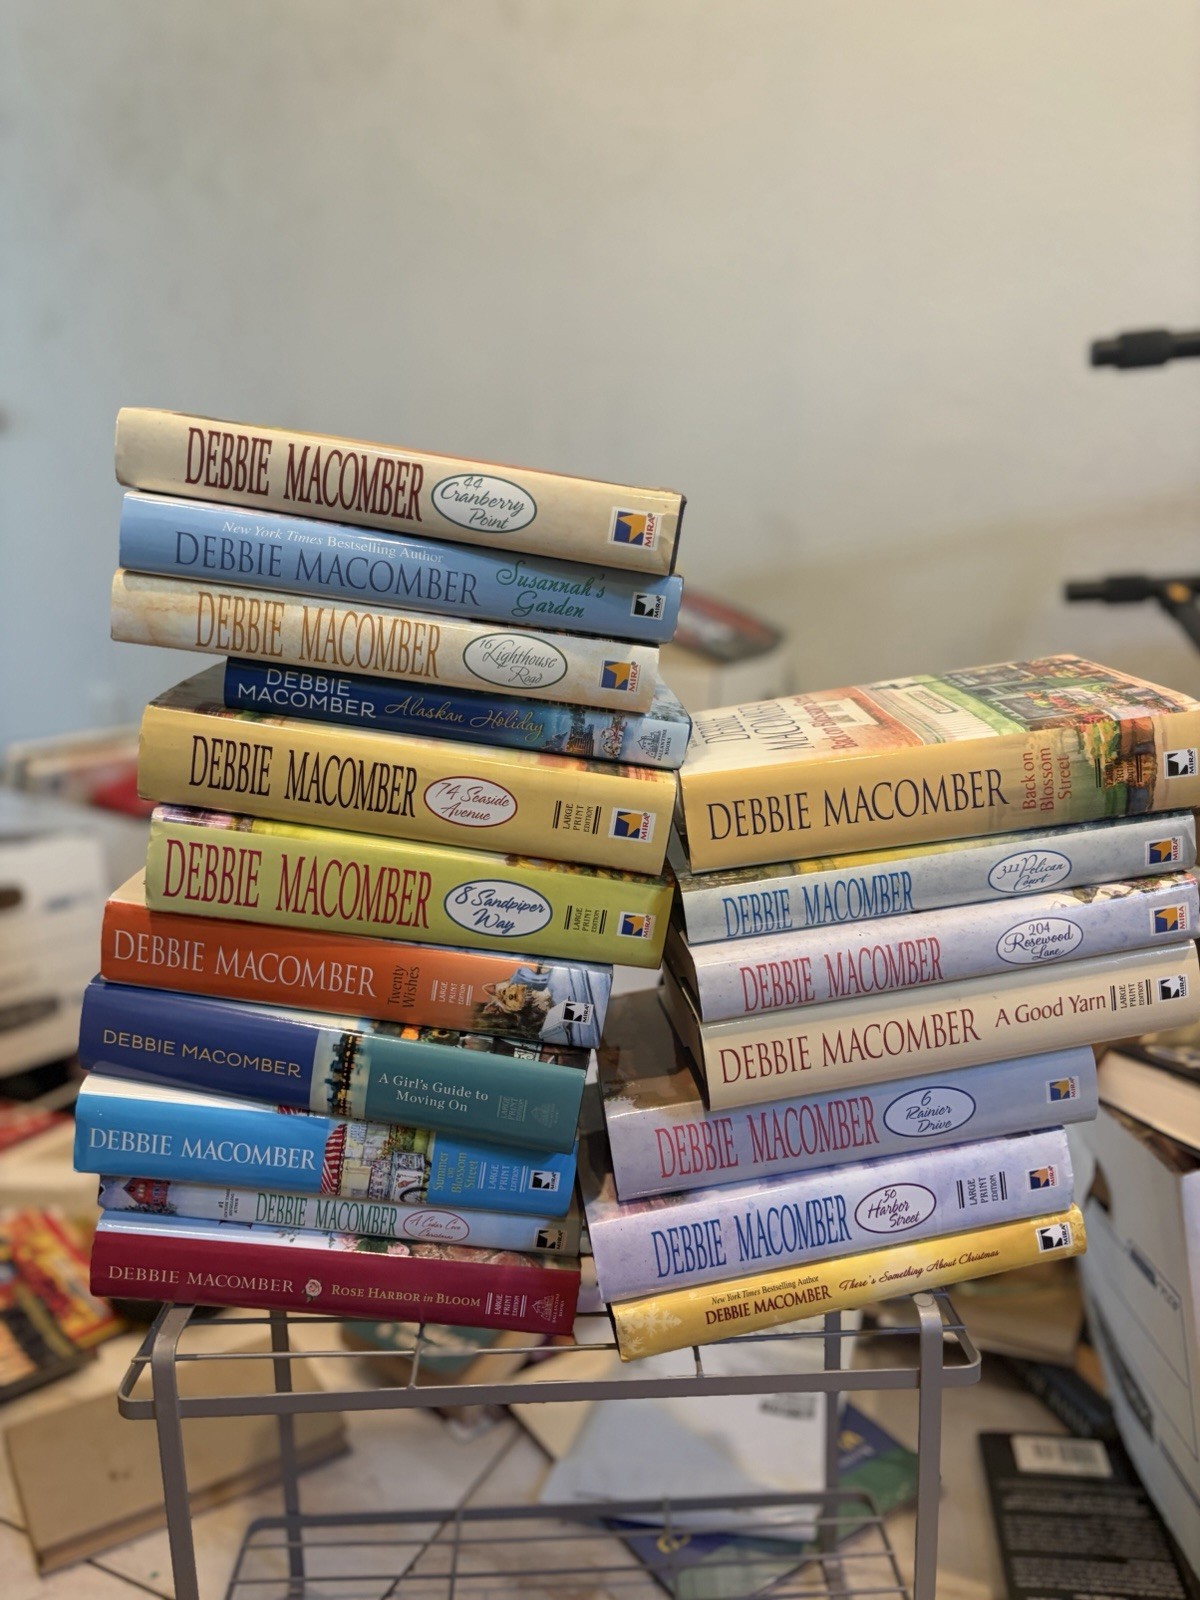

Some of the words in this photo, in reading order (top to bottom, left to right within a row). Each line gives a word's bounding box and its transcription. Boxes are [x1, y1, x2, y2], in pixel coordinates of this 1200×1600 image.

[185, 427, 272, 496] DEBBIE
[284, 443, 424, 522] MACOMBER
[463, 476, 483, 490] 44
[440, 482, 525, 516] Cranberry
[470, 508, 508, 530] Point
[222, 521, 251, 537] New
[253, 525, 282, 540] York
[286, 530, 323, 546] Times
[328, 536, 396, 558] Bestselling
[400, 548, 443, 563] Author
[174, 531, 282, 578] DEBBIE
[295, 550, 480, 606] MACOMBER
[496, 560, 605, 598] Susannah's
[511, 590, 584, 618] Garden
[196, 591, 285, 657] DEBBIE
[299, 605, 440, 678] MACOMBER
[480, 639, 492, 649] 16
[482, 640, 557, 670] Lighthouse
[267, 669, 351, 696] DEBBIE
[510, 666, 542, 685] Road
[238, 683, 376, 718] MACOMBER
[385, 695, 465, 724] Alaskan
[470, 710, 544, 742] Holiday
[1023, 752, 1034, 771] on
[189, 735, 272, 796] DEBBIE
[284, 750, 417, 818] MACOMBER
[1040, 748, 1054, 810] Blossom
[1057, 754, 1072, 800] Street
[436, 782, 460, 800] 74
[460, 787, 510, 807] Seaside
[707, 792, 811, 840] DEBBIE
[824, 769, 1010, 827] MACOMBER
[1021, 774, 1036, 810] Back
[441, 802, 490, 820] Avenue
[563, 804, 573, 829] LARGE
[573, 805, 584, 831] PRINT
[584, 806, 593, 832] EDITION
[1018, 854, 1065, 877] Pelican
[163, 839, 262, 908] DEBBIE
[276, 854, 432, 929] MACOMBER
[1014, 873, 1052, 891] Court
[454, 886, 468, 904] 8
[471, 889, 545, 913] Sandpiper
[722, 889, 792, 937] DEBBIE
[802, 871, 915, 926] MACOMBER
[473, 908, 515, 932] Way
[573, 908, 582, 930] LARGE
[582, 909, 592, 931] PRINT
[1029, 922, 1050, 935] 204
[1004, 926, 1074, 951] Rosewood
[114, 930, 204, 972] DEBBIE
[214, 946, 377, 998] MACOMBER
[1031, 947, 1064, 961] Lane
[387, 965, 408, 1005] Twenty
[402, 967, 419, 1007] Wishes
[740, 957, 816, 1012] DEBBIE
[824, 936, 943, 998] MACOMBER
[439, 982, 448, 1002] LARGE
[448, 983, 457, 1003] PRINT
[995, 1009, 1010, 1027] A
[1015, 998, 1063, 1023] Good
[1069, 995, 1106, 1013] Yarn
[103, 1030, 175, 1056] DEBBIE
[182, 1044, 300, 1078] MACOMBER
[719, 1035, 812, 1084] DEBBIE
[822, 1009, 981, 1067] MACOMBER
[379, 1073, 388, 1084] A
[393, 1075, 428, 1091] Girl's
[432, 1082, 472, 1098] Guide
[476, 1090, 488, 1101] to
[921, 1091, 931, 1106] 6
[396, 1090, 445, 1110] Moving
[449, 1100, 468, 1112] On
[906, 1105, 952, 1120] Rainier
[655, 1117, 739, 1178] DEBBIE
[746, 1096, 879, 1163] MACOMBER
[917, 1119, 952, 1133] Drive
[90, 1128, 172, 1156] DEBBIE
[182, 1138, 316, 1170] MACOMBER
[434, 1152, 448, 1191] Summer
[451, 1153, 467, 1192] Blossom
[465, 1161, 478, 1188] Street
[489, 1164, 499, 1189] LARGE
[499, 1166, 510, 1190] PRINT
[510, 1166, 519, 1191] EDITION
[884, 1189, 897, 1202] 50
[968, 1178, 976, 1206] LARGE
[979, 1177, 987, 1204] PRINT
[990, 1174, 998, 1202] EDITION
[255, 1193, 308, 1226] DEBBIE
[315, 1200, 397, 1236] MACOMBER
[868, 1200, 910, 1219] Harbor
[890, 1212, 920, 1227] Street
[651, 1219, 726, 1278] DEBBIE
[734, 1194, 852, 1262] MACOMBER
[109, 1265, 180, 1284] DEBBIE
[187, 1272, 293, 1293] MACOMBER
[838, 1275, 876, 1291] There's
[879, 1266, 924, 1282] Something
[926, 1259, 957, 1272] About
[959, 1250, 1000, 1264] Christmas
[423, 1294, 433, 1302] in
[742, 1290, 760, 1298] Times
[762, 1281, 796, 1294] Bestselling
[797, 1276, 819, 1286] Author
[494, 1294, 503, 1314] LARGE
[503, 1295, 512, 1315] PRINT
[705, 1303, 751, 1325] DEBBIE
[754, 1285, 832, 1314] MACOMBER
